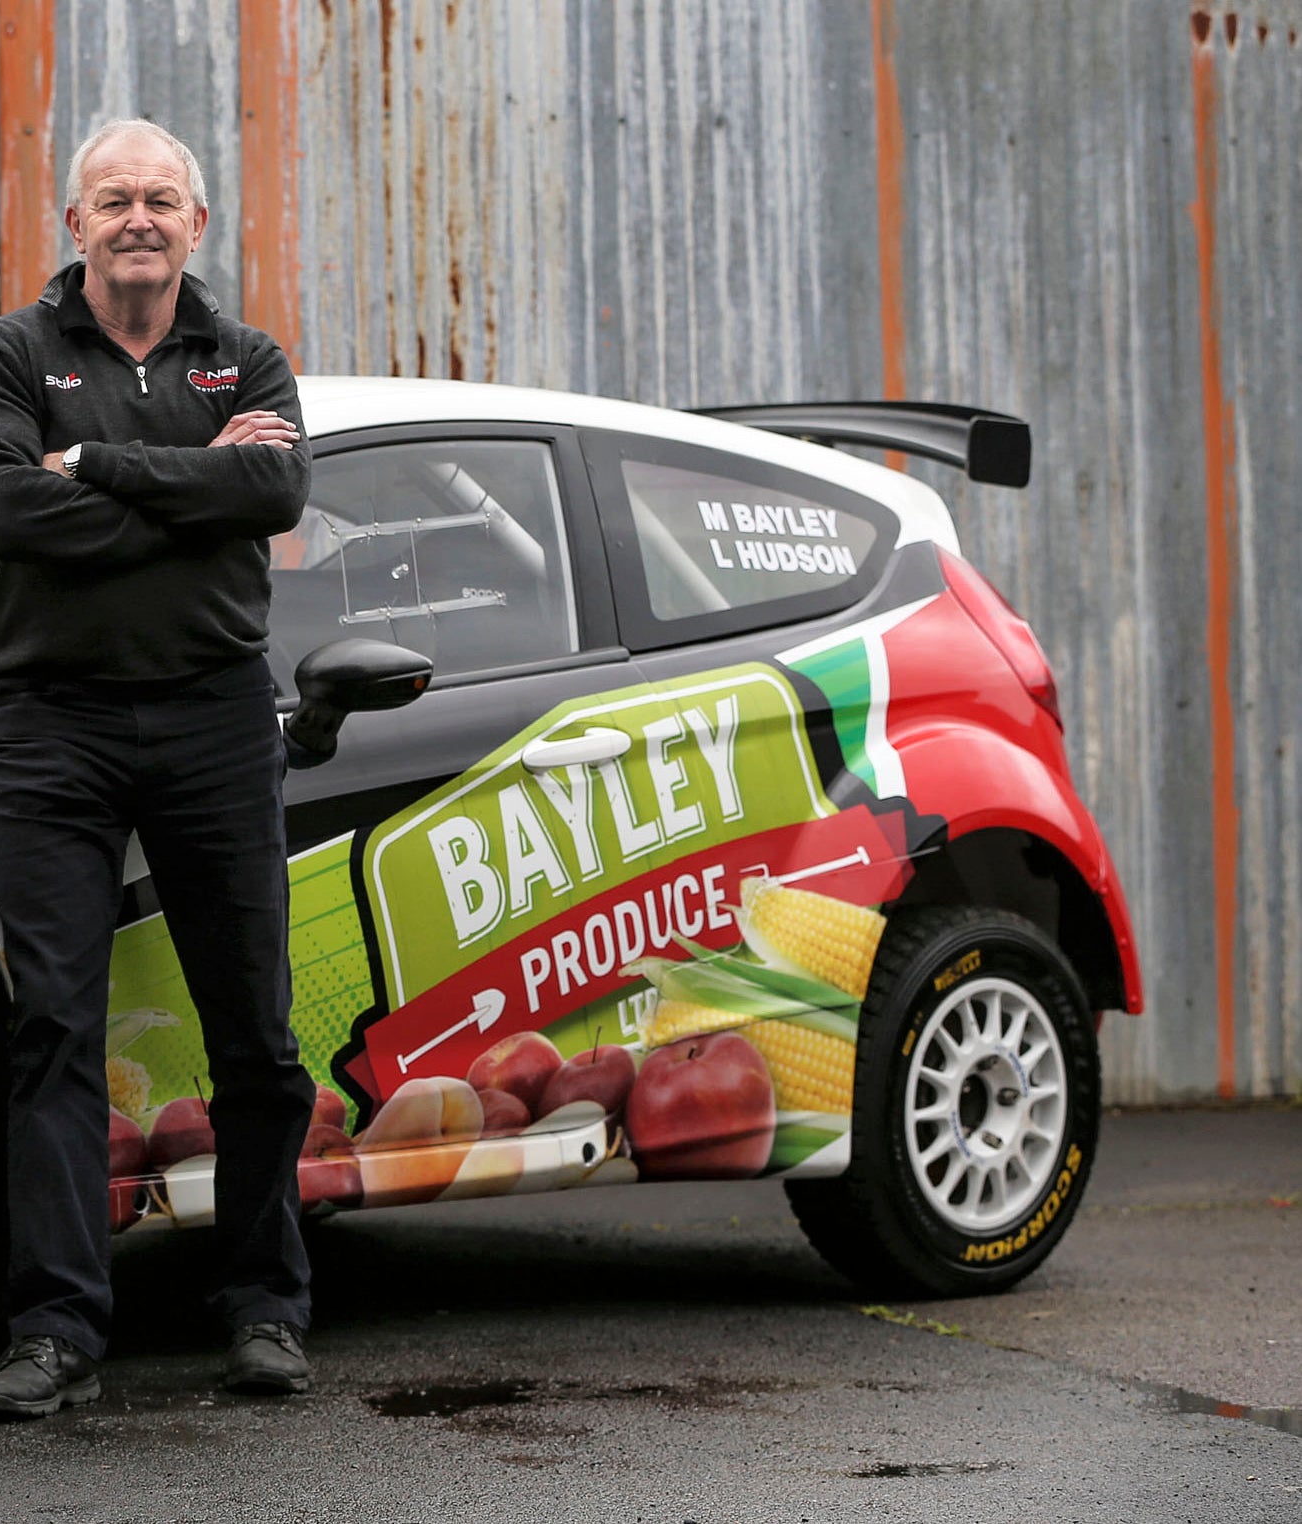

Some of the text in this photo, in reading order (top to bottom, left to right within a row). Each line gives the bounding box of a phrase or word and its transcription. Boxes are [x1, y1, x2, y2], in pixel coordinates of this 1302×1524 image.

[45, 372, 82, 390] Stilo
[698, 502, 839, 538] M BAYLEY
[709, 539, 858, 575] L HUDSON
[426, 694, 744, 948] BAYLEY
[519, 864, 733, 1014] PRODUCE
[965, 1143, 1083, 1262] SCORPION
